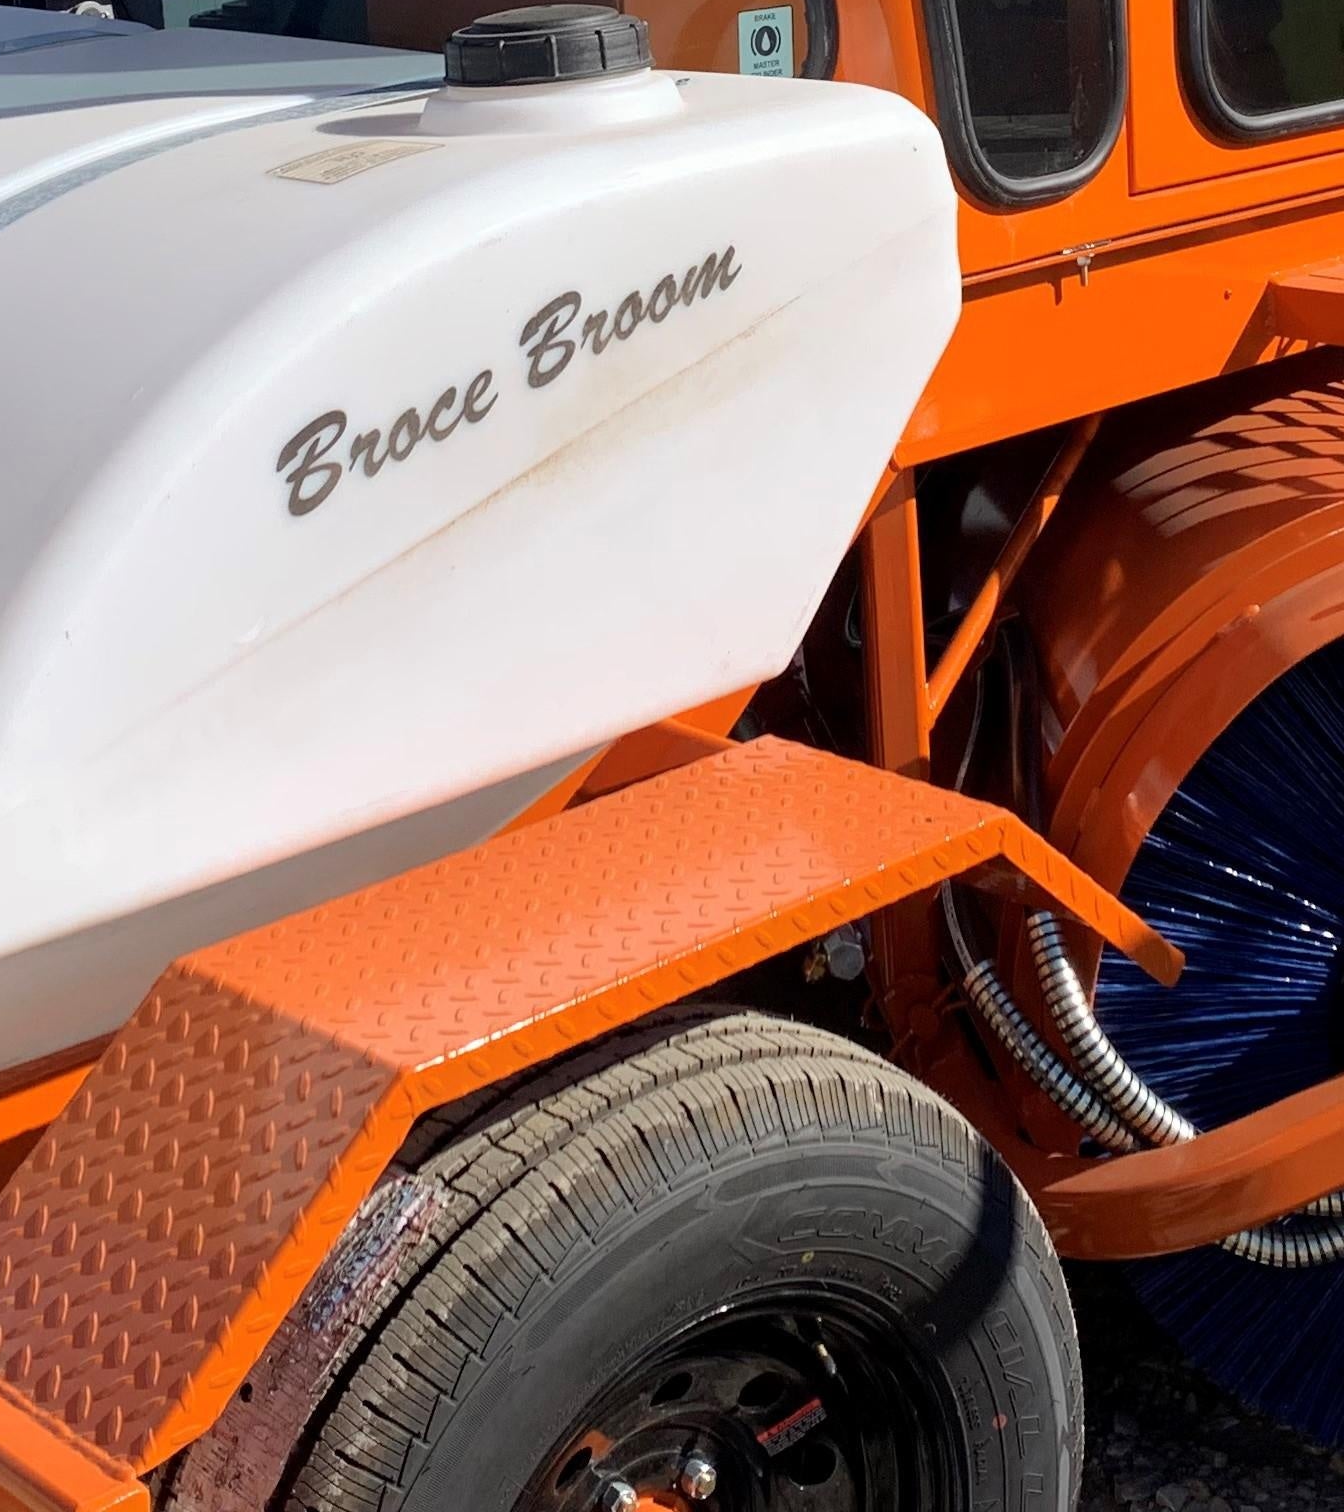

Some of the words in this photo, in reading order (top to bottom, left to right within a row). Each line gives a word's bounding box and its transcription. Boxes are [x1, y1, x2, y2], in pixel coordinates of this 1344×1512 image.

[754, 13, 776, 22] BRAKE
[753, 59, 780, 69] MASTER
[276, 369, 499, 517] Broce
[519, 245, 743, 388] Broom
